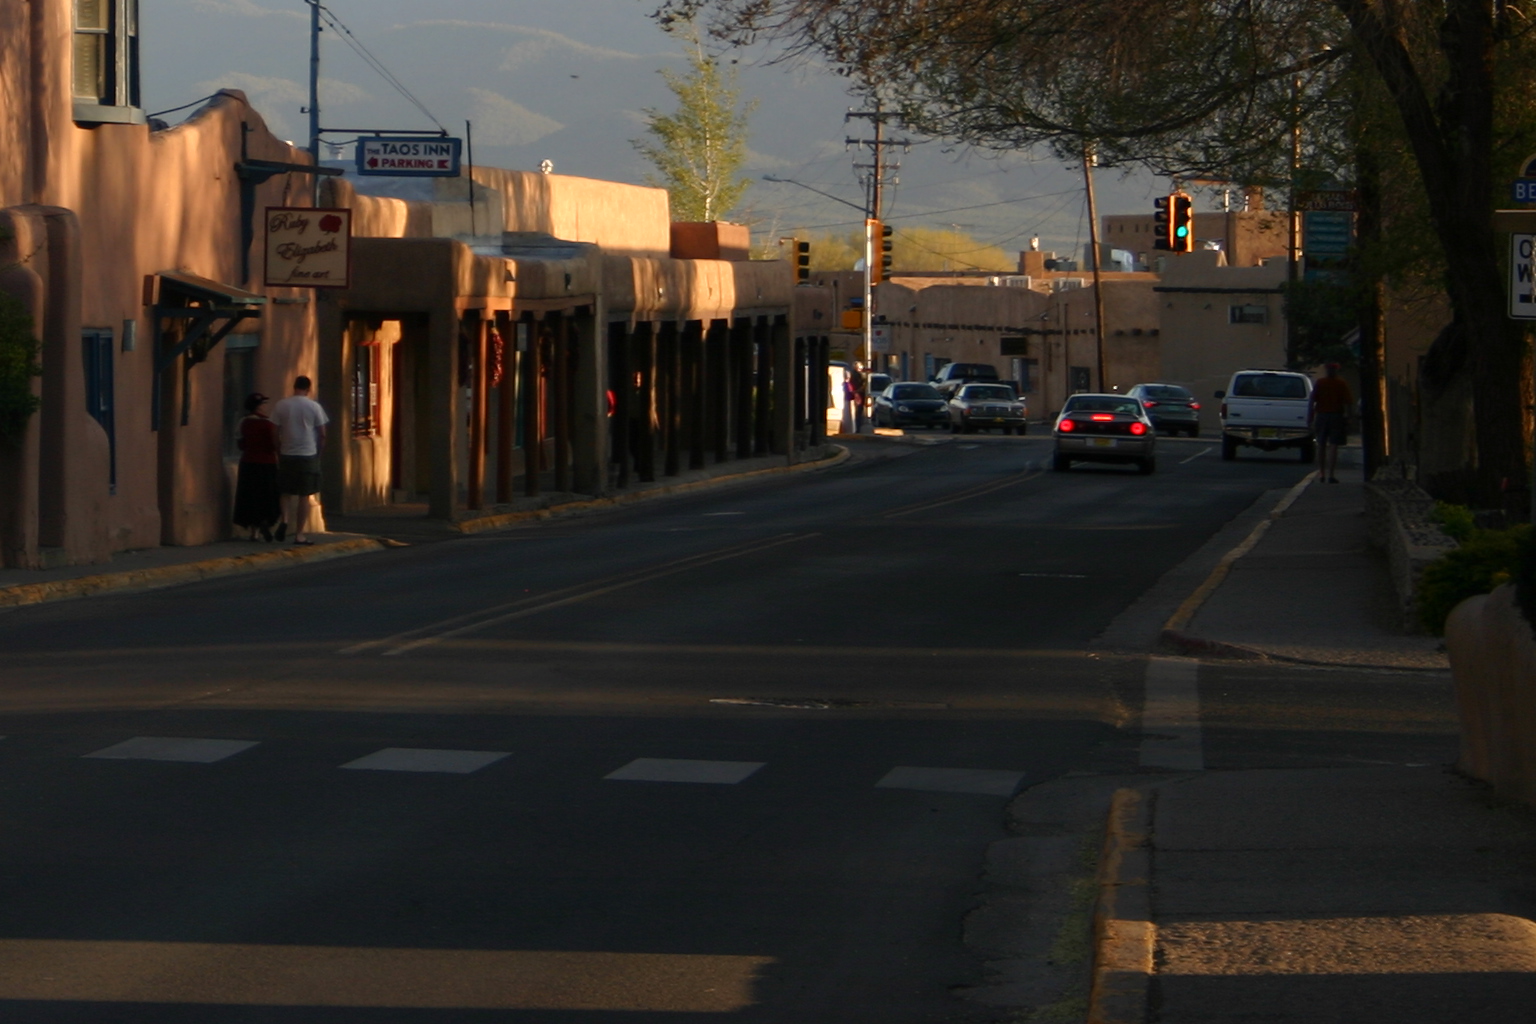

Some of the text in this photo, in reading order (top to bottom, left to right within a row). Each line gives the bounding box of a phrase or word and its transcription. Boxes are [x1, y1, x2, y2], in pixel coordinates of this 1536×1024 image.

[367, 143, 450, 156] THE TAOS INN
[381, 159, 434, 169] PARKING
[269, 212, 309, 235] Ruby
[276, 238, 338, 264] Elizabeth
[312, 269, 330, 279] art
